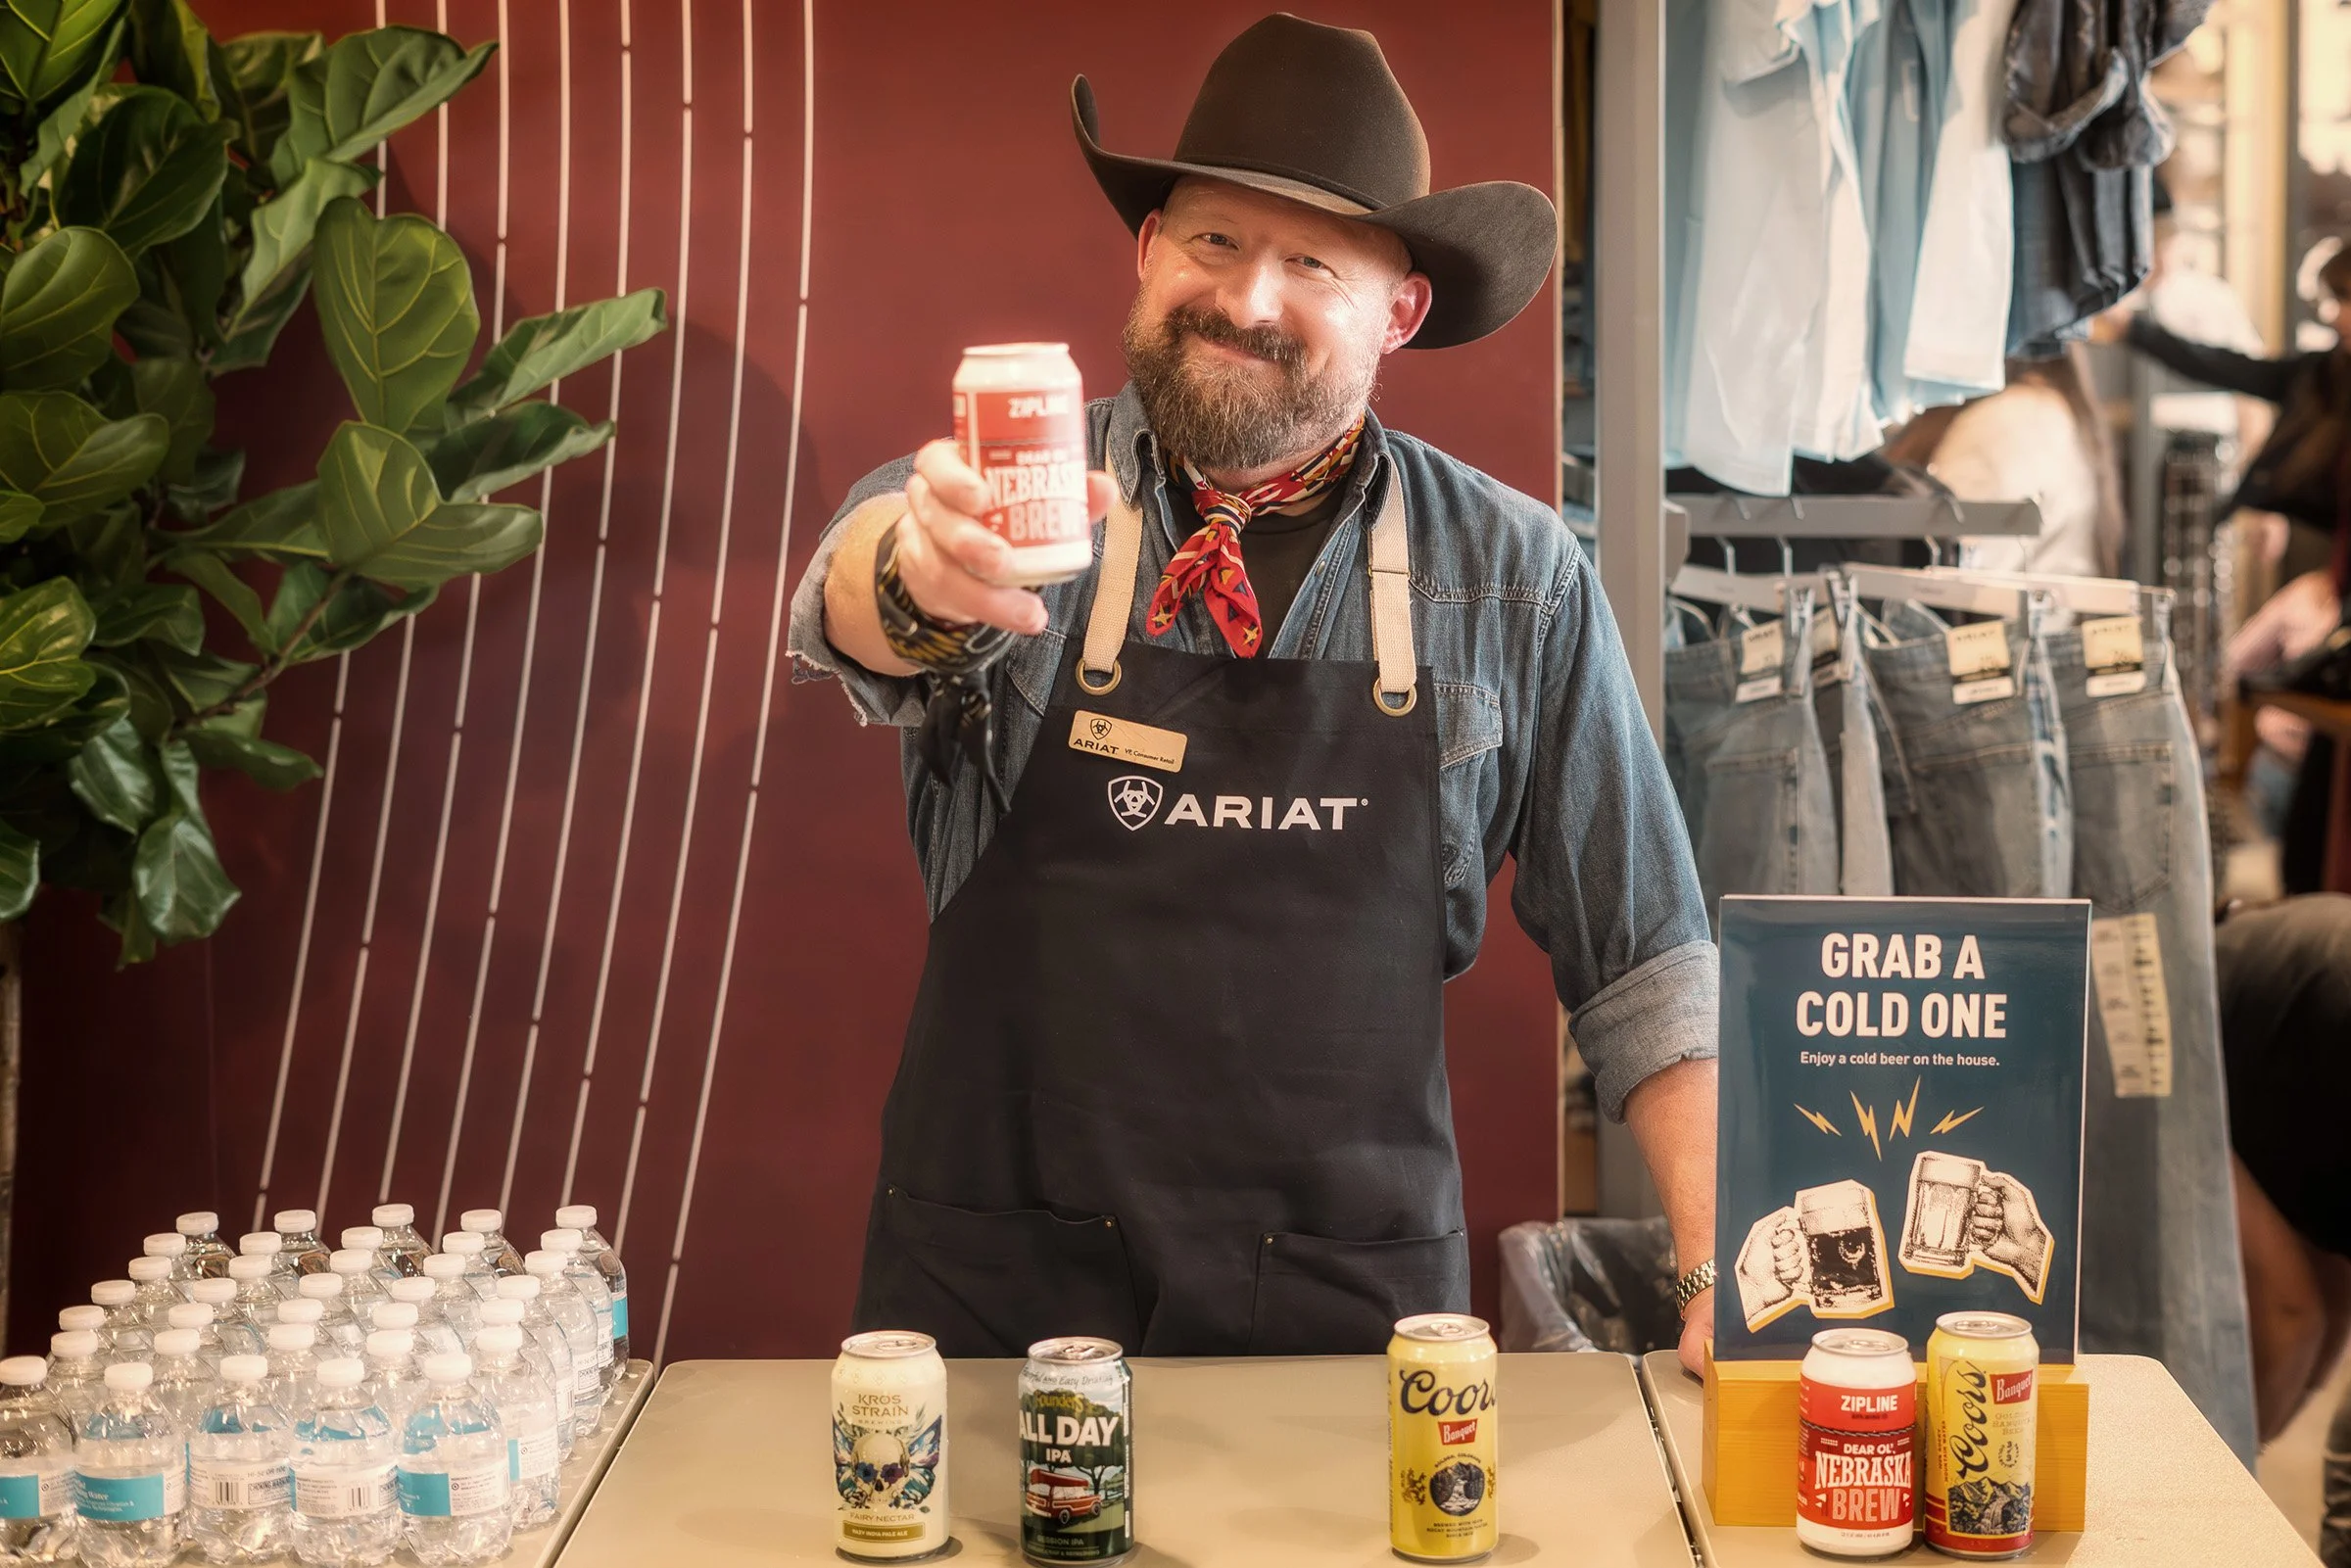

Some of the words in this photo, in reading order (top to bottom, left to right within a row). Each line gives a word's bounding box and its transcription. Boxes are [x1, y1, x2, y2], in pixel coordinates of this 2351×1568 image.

[1073, 737, 1120, 755] ARIAT
[1133, 750, 1160, 762] Consumer
[1160, 756, 1176, 765] Retail
[1164, 792, 1358, 831] ARIAT
[1820, 931, 1942, 979] GRAB
[1952, 934, 1986, 979] A
[1796, 990, 1909, 1038] COLD
[1920, 992, 2007, 1039] ONE
[1799, 1051, 1837, 1067] Enjoy
[1838, 1056, 1847, 1066] a
[1849, 1052, 1878, 1066] cold
[1879, 1053, 1911, 1066] beer
[1912, 1056, 1930, 1067] on
[1932, 1054, 1954, 1067] the
[1956, 1054, 2001, 1067] house.
[1996, 1373, 2032, 1402] Banquet
[852, 1404, 909, 1417] STRAIN
[858, 1394, 902, 1406] KROS
[1841, 1395, 1898, 1412] ZIPLINE
[1949, 1360, 1989, 1480] Coors
[1056, 1415, 1119, 1447] DAY
[1442, 1421, 1476, 1445] Banquet
[1045, 1449, 1072, 1463] IPA
[1843, 1443, 1875, 1455] DEAR
[1814, 1450, 1911, 1490] NEBRASKA
[1832, 1488, 1900, 1522] BREW
[849, 1511, 875, 1522] FAIRY
[876, 1513, 915, 1523] NECTAR
